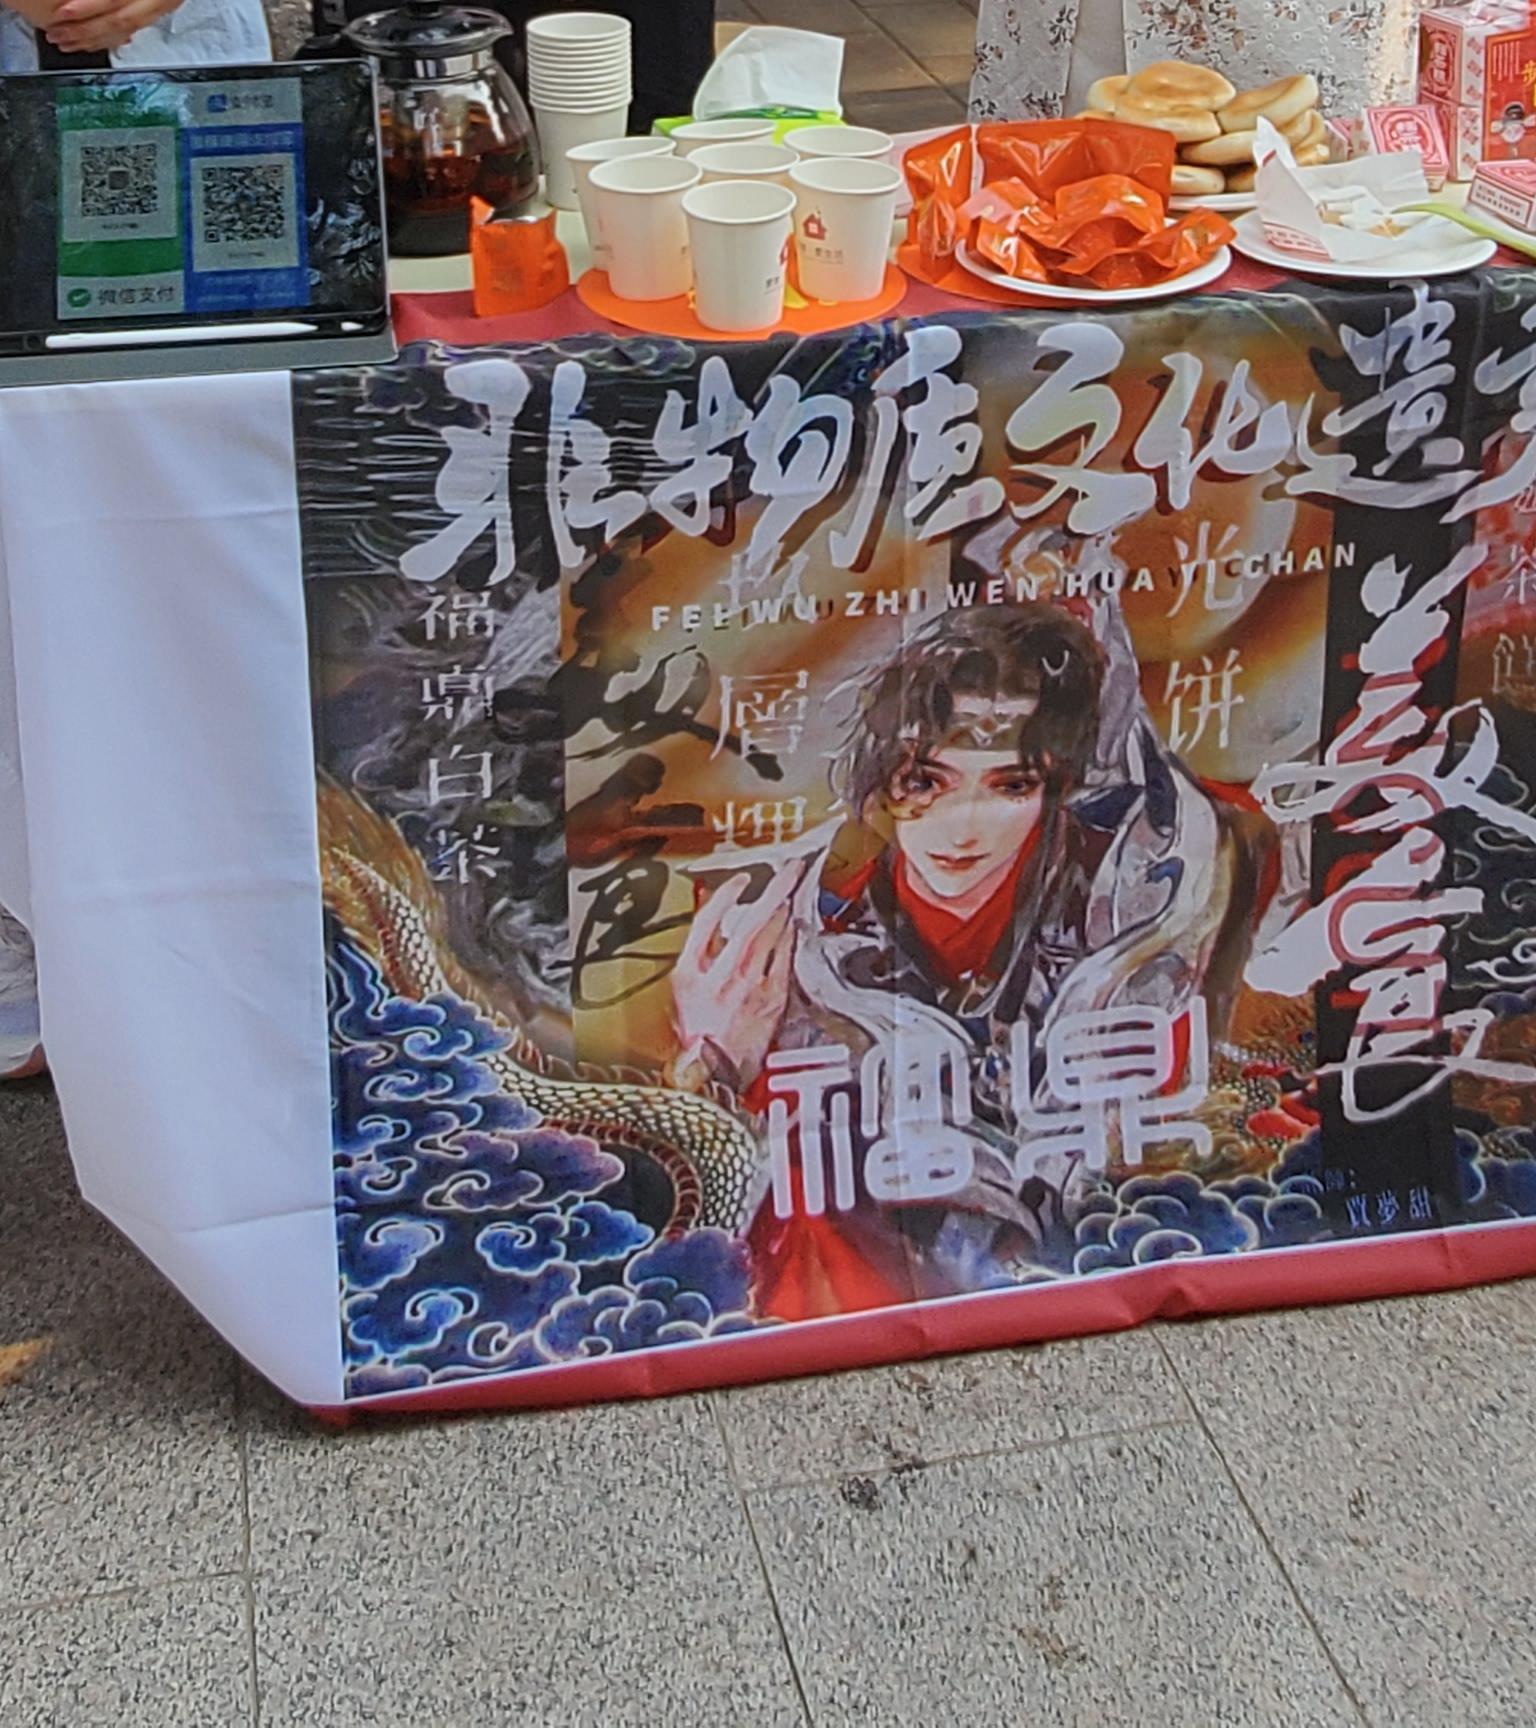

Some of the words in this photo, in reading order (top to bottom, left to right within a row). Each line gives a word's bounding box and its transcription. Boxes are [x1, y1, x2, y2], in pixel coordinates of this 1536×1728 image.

[844, 586, 920, 618] ZHI
[946, 577, 1038, 608] WEN
[1066, 567, 1155, 598] HUA
[1242, 541, 1357, 580] CHAN
